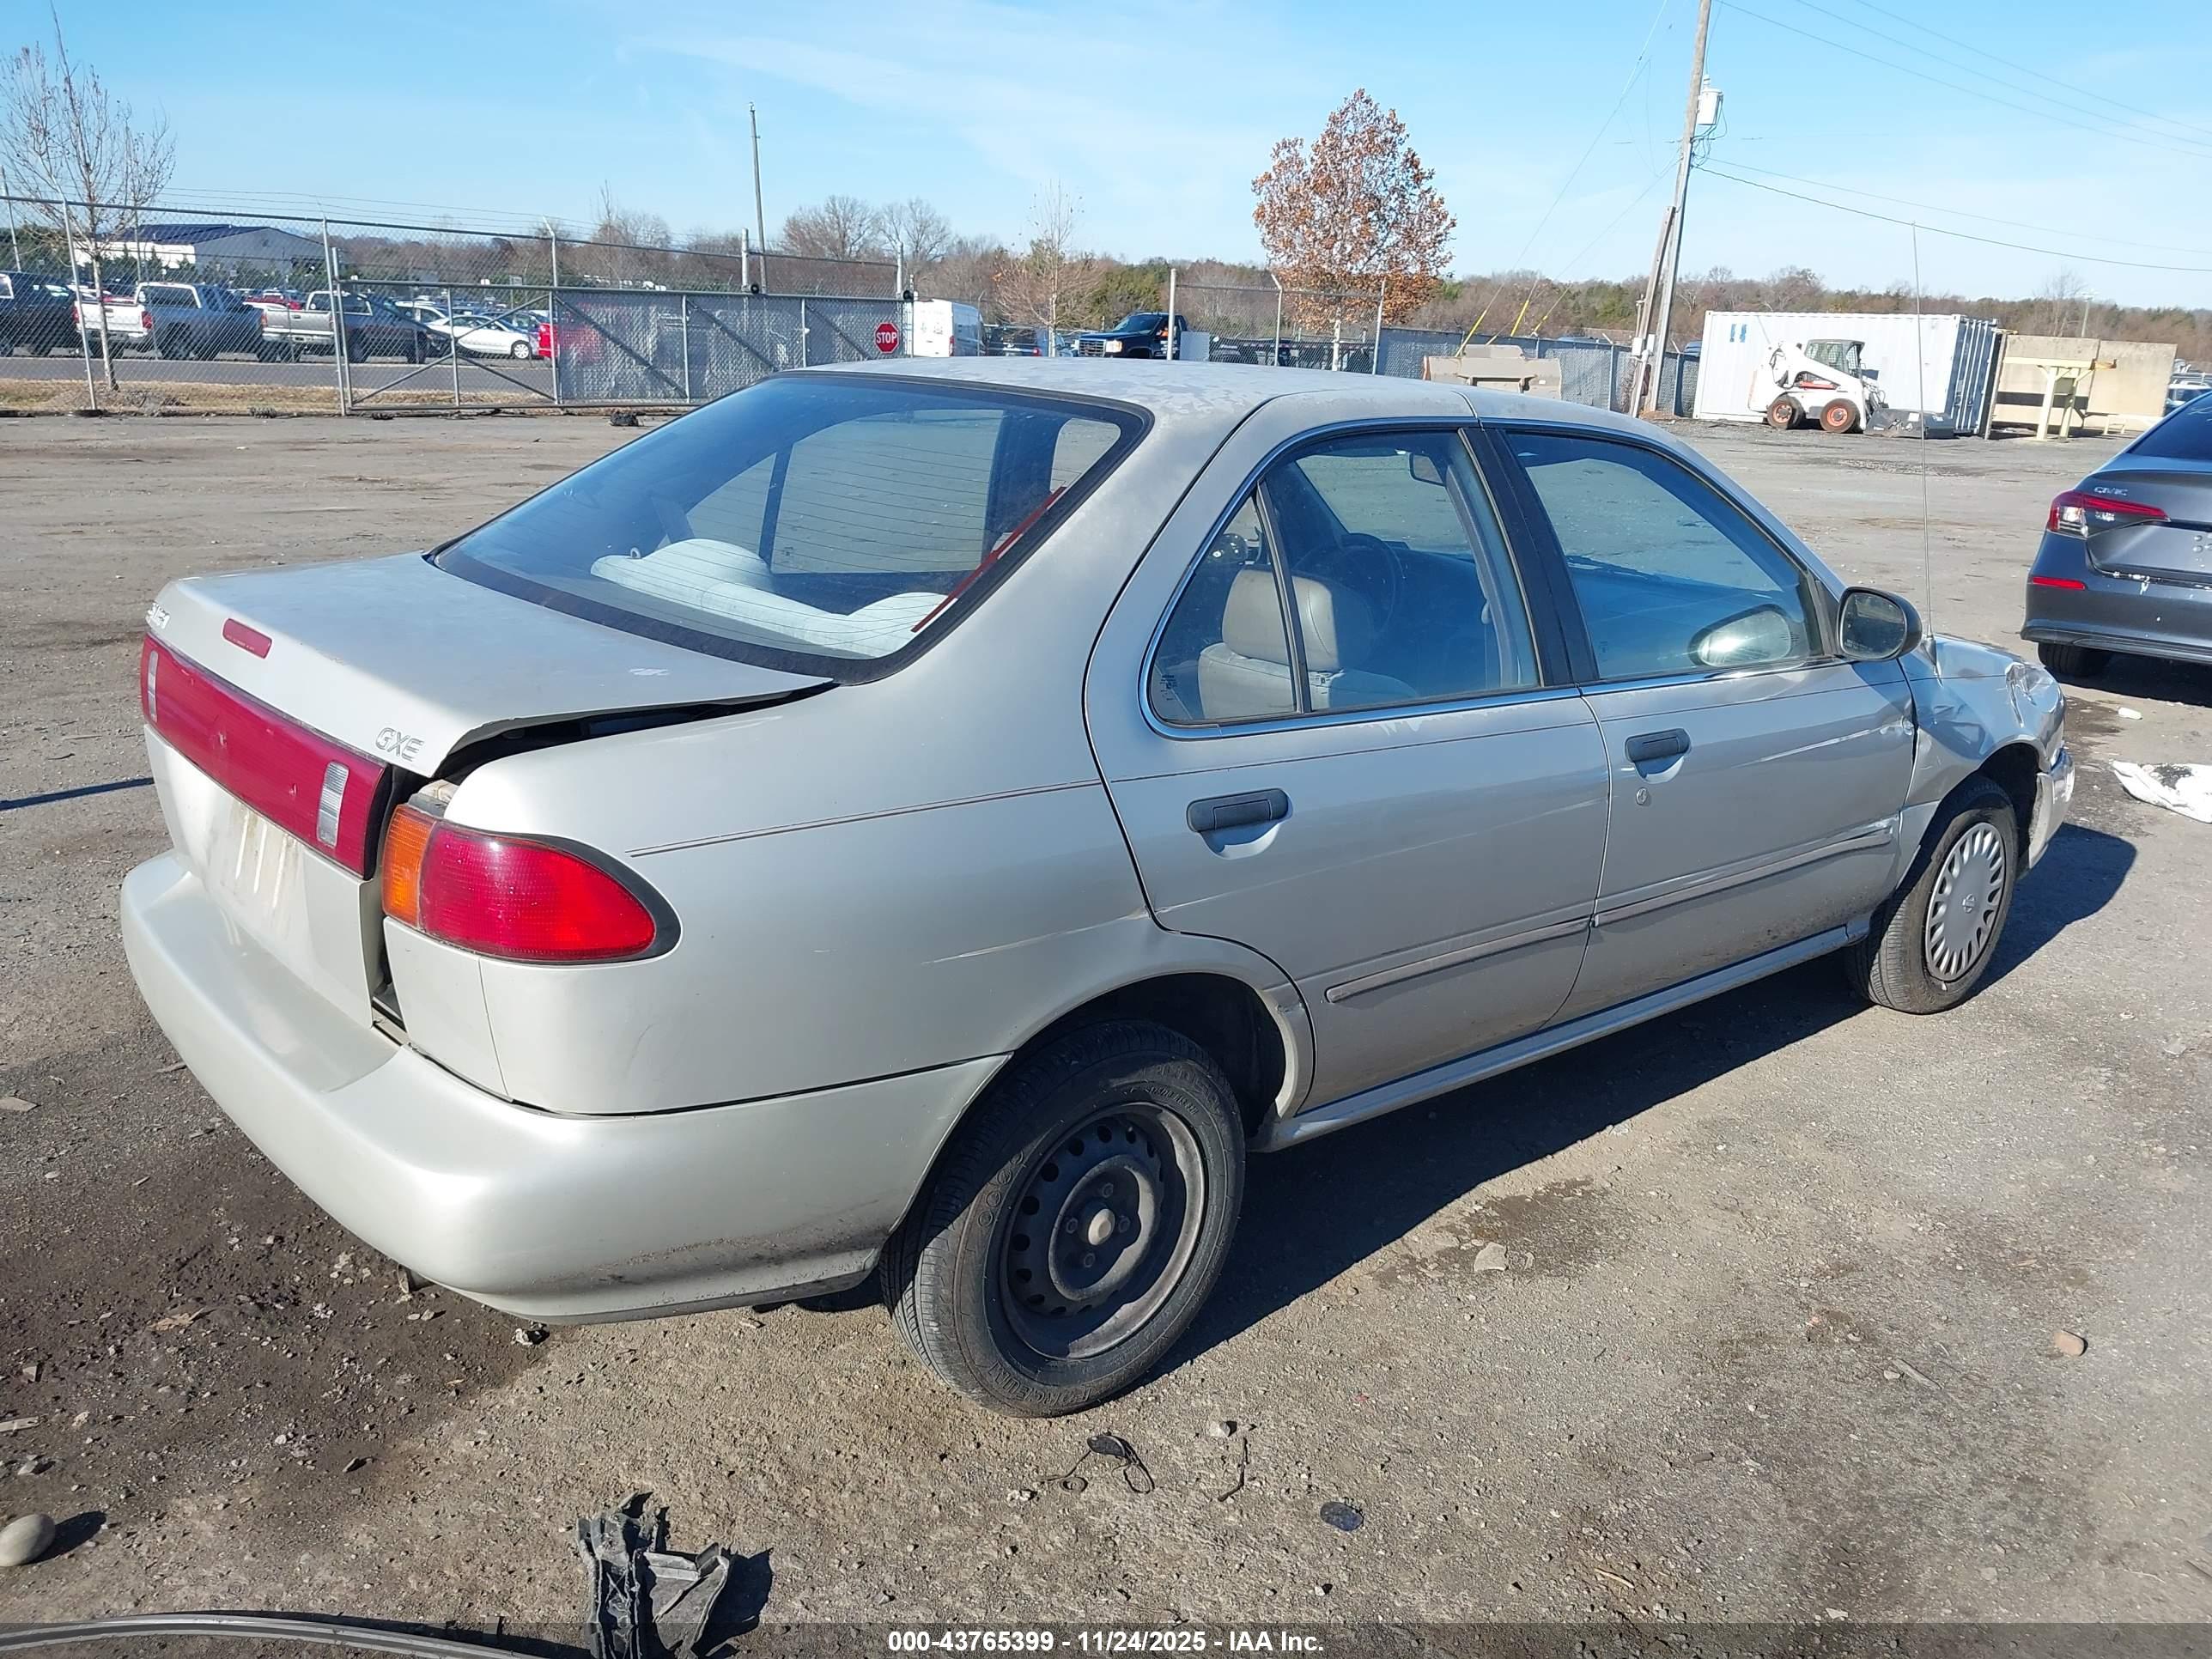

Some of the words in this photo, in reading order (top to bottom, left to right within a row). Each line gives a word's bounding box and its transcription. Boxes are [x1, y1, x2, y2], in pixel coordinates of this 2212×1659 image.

[876, 331, 897, 344] STOP
[2094, 486, 2129, 496] CIVIC
[375, 726, 425, 763] GXE
